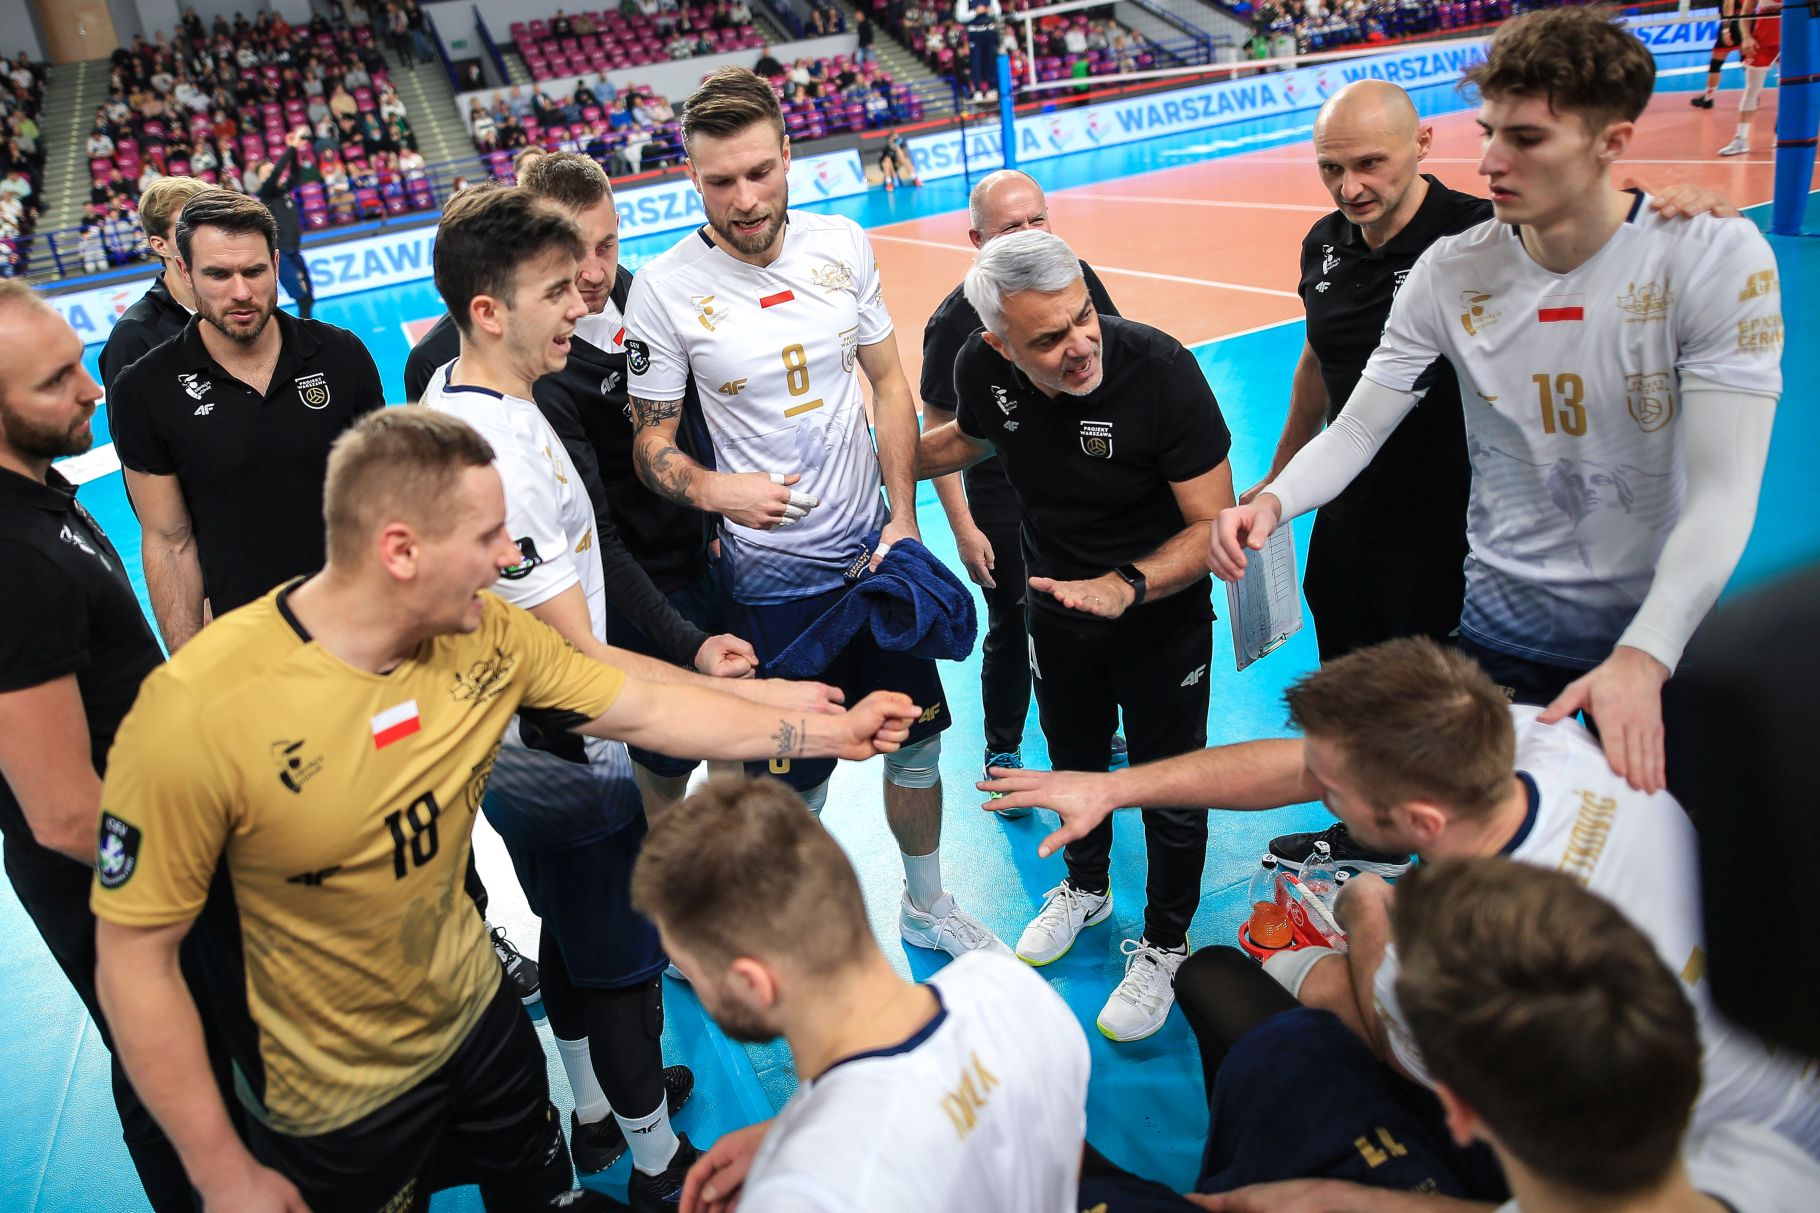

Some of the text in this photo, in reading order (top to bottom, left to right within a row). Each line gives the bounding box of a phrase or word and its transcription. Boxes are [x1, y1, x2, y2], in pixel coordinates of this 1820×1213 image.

[1116, 84, 1278, 133] WARSZAWA
[309, 238, 435, 287] SZAW
[782, 343, 810, 397] 8
[1532, 373, 1588, 437] 13
[1080, 430, 1112, 438] WARSZAWA
[384, 791, 440, 880] 18
